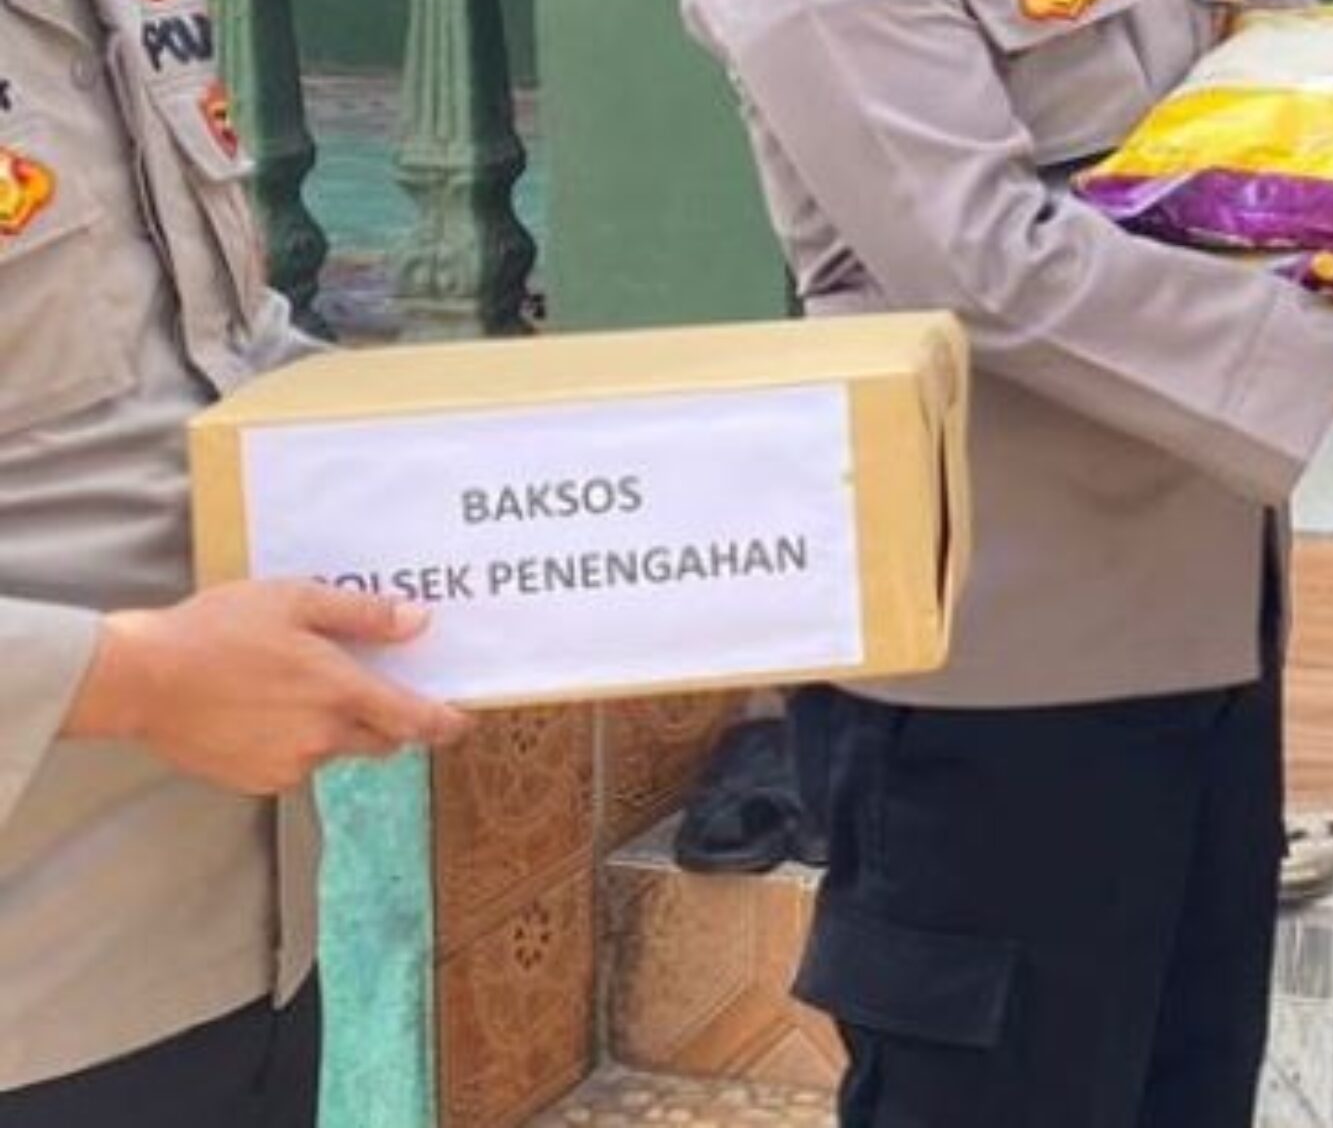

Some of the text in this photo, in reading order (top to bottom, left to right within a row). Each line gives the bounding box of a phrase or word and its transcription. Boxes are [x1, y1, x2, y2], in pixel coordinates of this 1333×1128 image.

[461, 475, 643, 524] BAKSOS
[312, 535, 807, 601] LSEK PENENGAHAN
